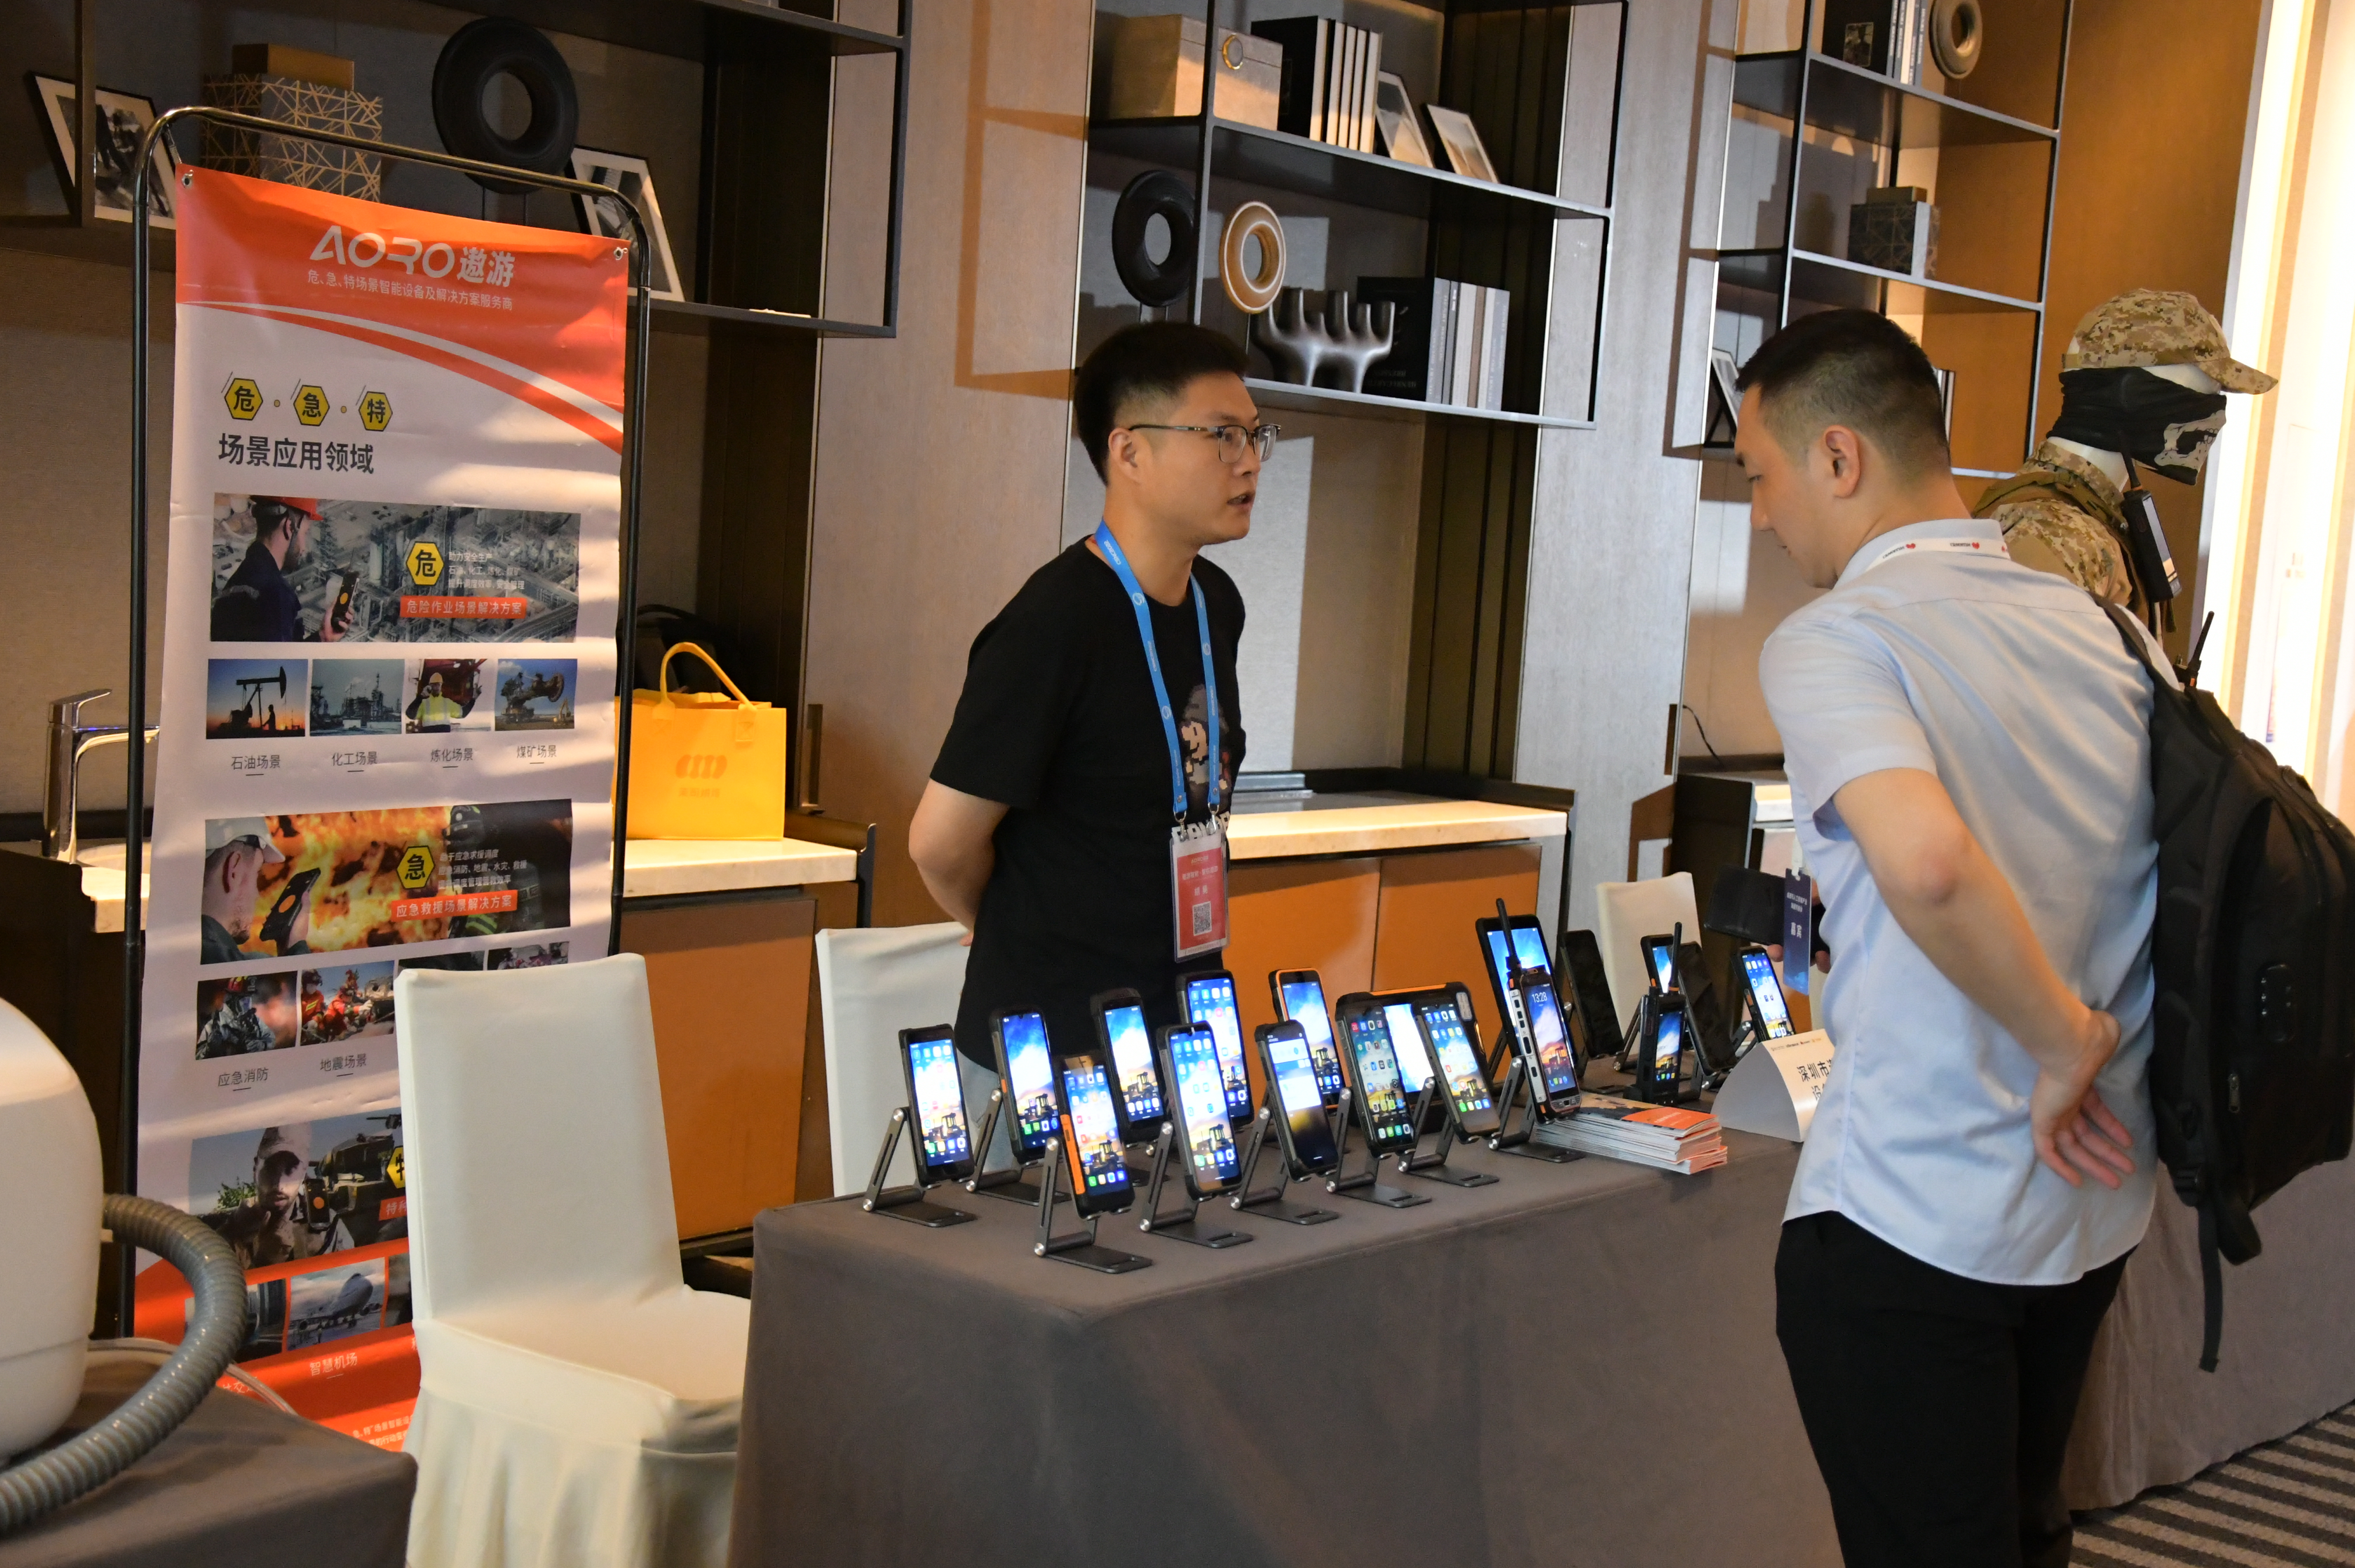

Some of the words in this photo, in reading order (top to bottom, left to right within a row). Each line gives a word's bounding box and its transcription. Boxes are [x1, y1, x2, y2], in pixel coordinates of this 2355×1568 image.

[308, 269, 513, 311] 危、急、特场景智能设备及解决方案服务商
[233, 385, 255, 414] 危
[302, 393, 321, 419] 急
[366, 398, 387, 424] 特
[218, 432, 374, 475] 场景应用领域
[415, 550, 436, 577] 危
[449, 551, 493, 562] 助力安全生产
[407, 600, 522, 615] 危险作业场景解决方案
[331, 751, 378, 767] 化工场景
[430, 748, 474, 762] 炼化场景
[516, 745, 557, 759] 煤矿场景
[231, 755, 281, 771] 石油场景
[405, 854, 426, 880] 急
[396, 895, 512, 918] 应急救援场景解决方案
[319, 1053, 368, 1072] 地震场景
[217, 1068, 269, 1088] 应急消防
[309, 1352, 358, 1376] 智慧机场
